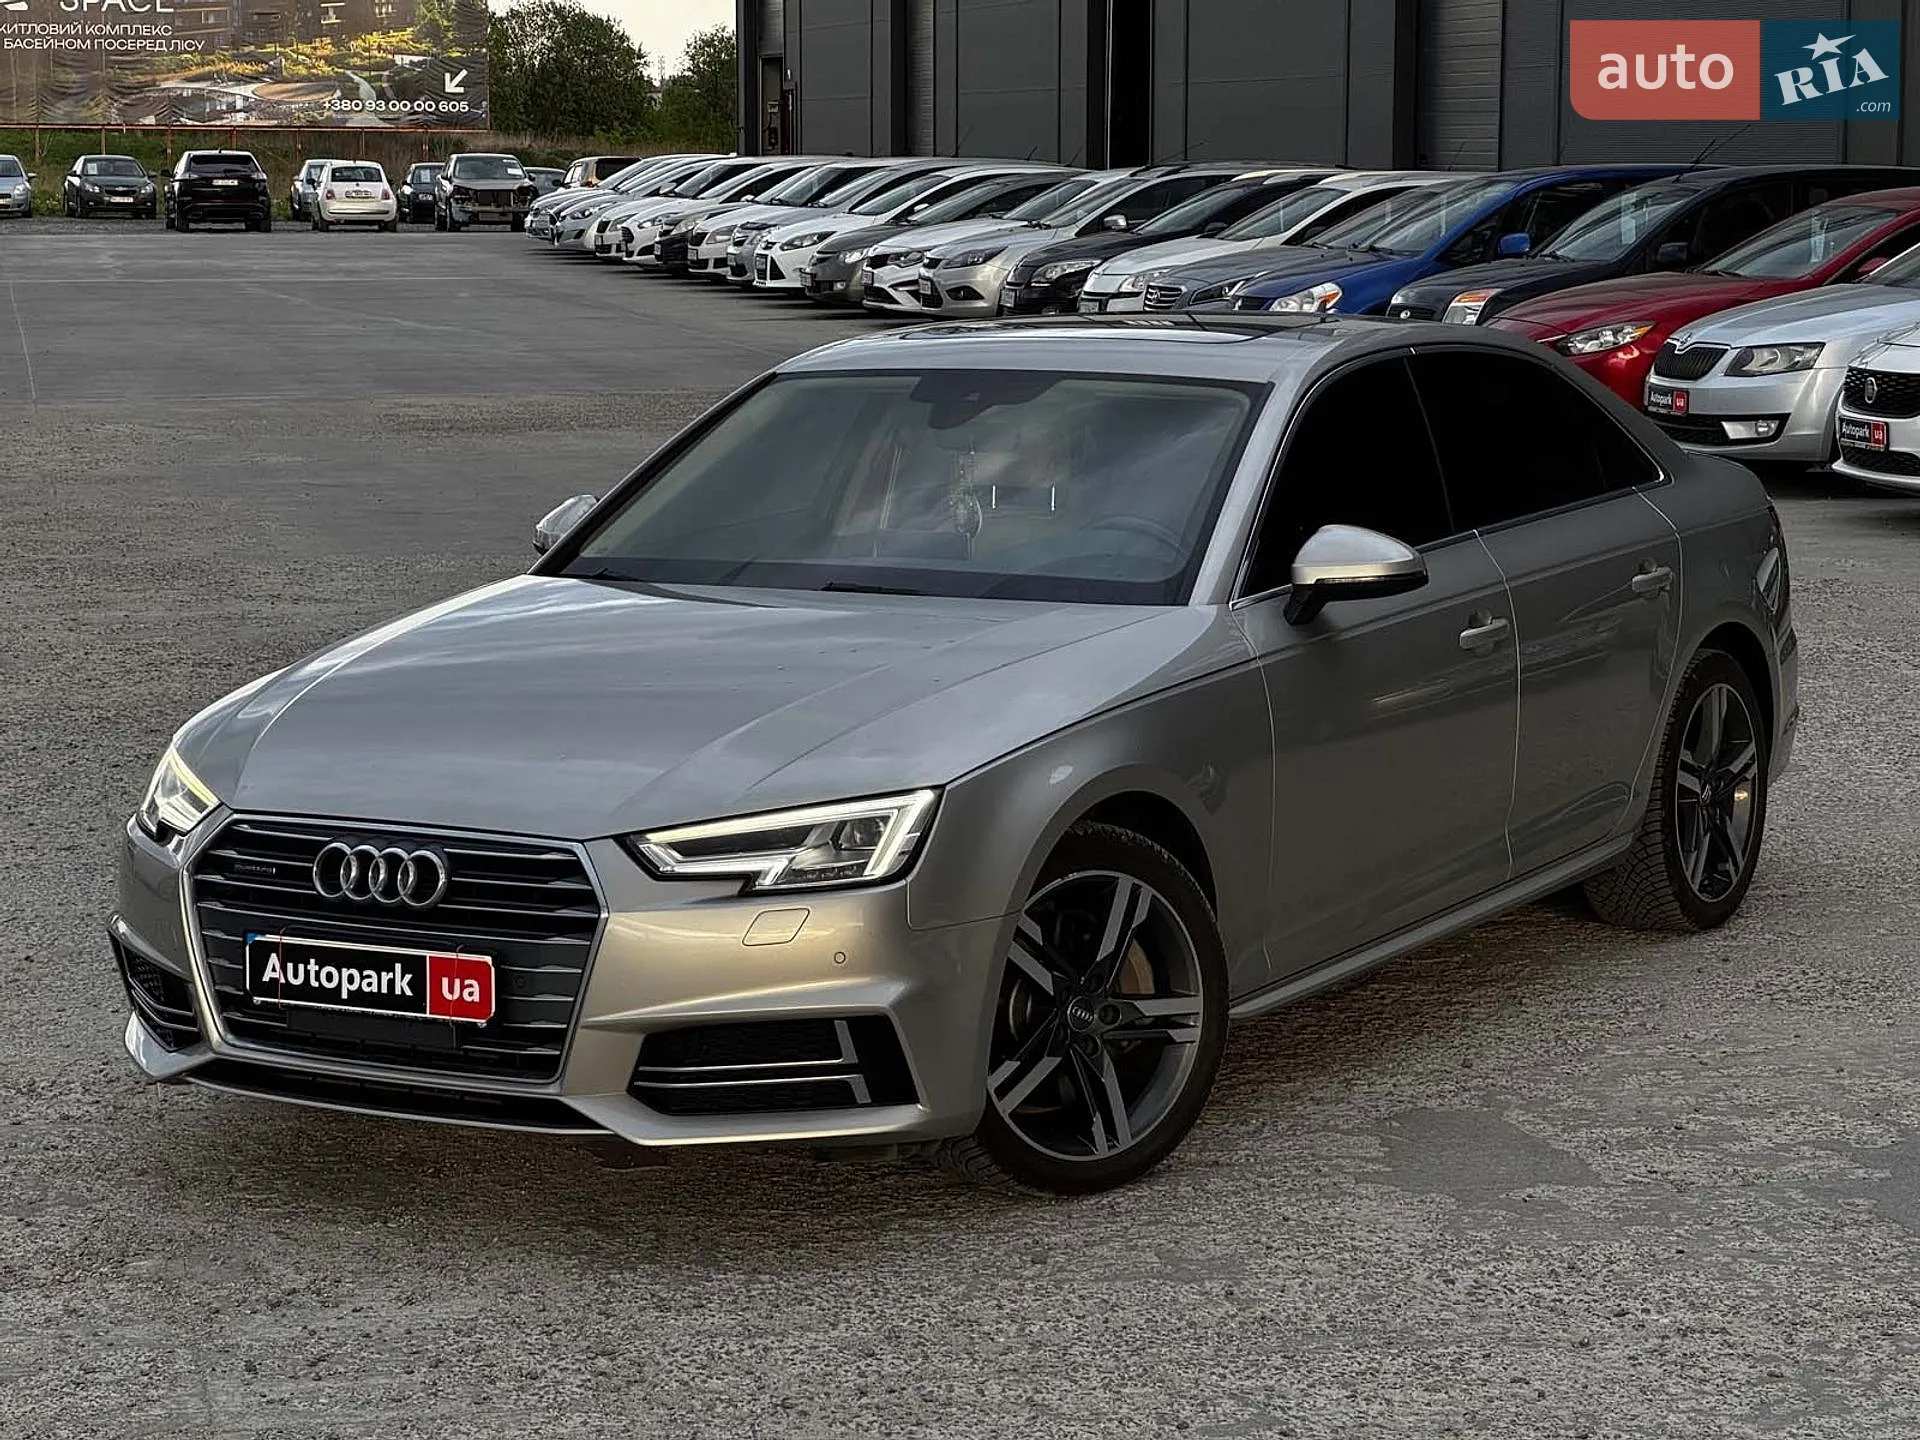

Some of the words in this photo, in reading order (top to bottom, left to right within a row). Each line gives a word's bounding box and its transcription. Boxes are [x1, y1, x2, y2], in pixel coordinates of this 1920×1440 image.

[85, 24, 172, 36] КОМПЛЕКС
[3, 36, 91, 50] БАСЕЙНОМ
[94, 39, 167, 52] ПОСЕРЕД
[170, 40, 205, 52] ЛІСУ
[323, 99, 363, 111] +380
[365, 100, 386, 111] 93
[388, 100, 411, 112] 00
[413, 100, 436, 112] 00
[438, 101, 469, 112] 605
[1841, 421, 1870, 439] Autopark
[261, 952, 414, 1000] Autopark
[441, 975, 481, 1003] ua
